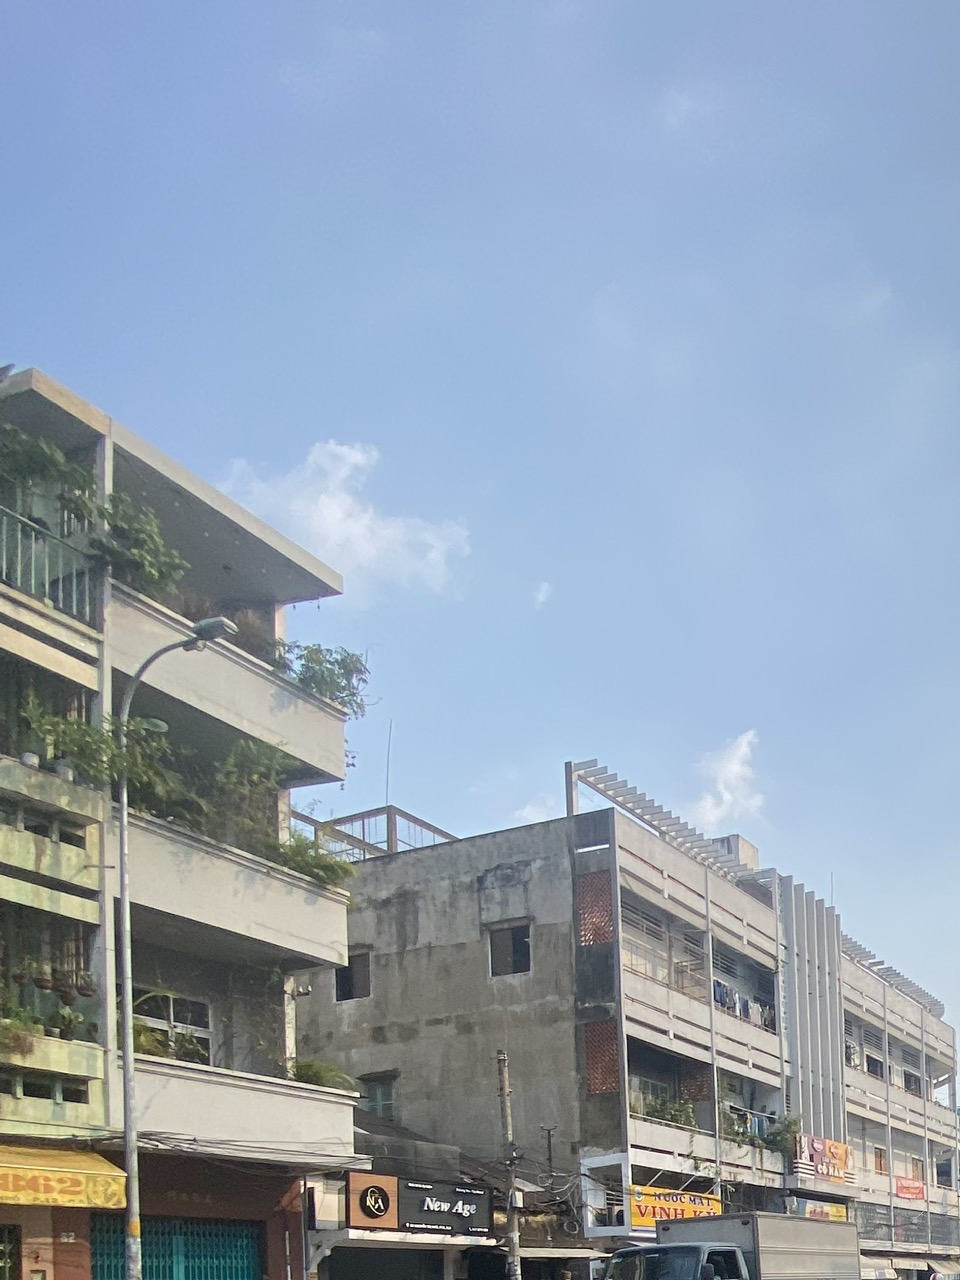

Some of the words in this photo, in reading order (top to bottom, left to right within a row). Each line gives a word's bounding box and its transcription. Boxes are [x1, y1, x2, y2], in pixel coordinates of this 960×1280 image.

[423, 1196, 451, 1212] New
[452, 1200, 477, 1217] Age
[635, 1204, 686, 1219] VINH
